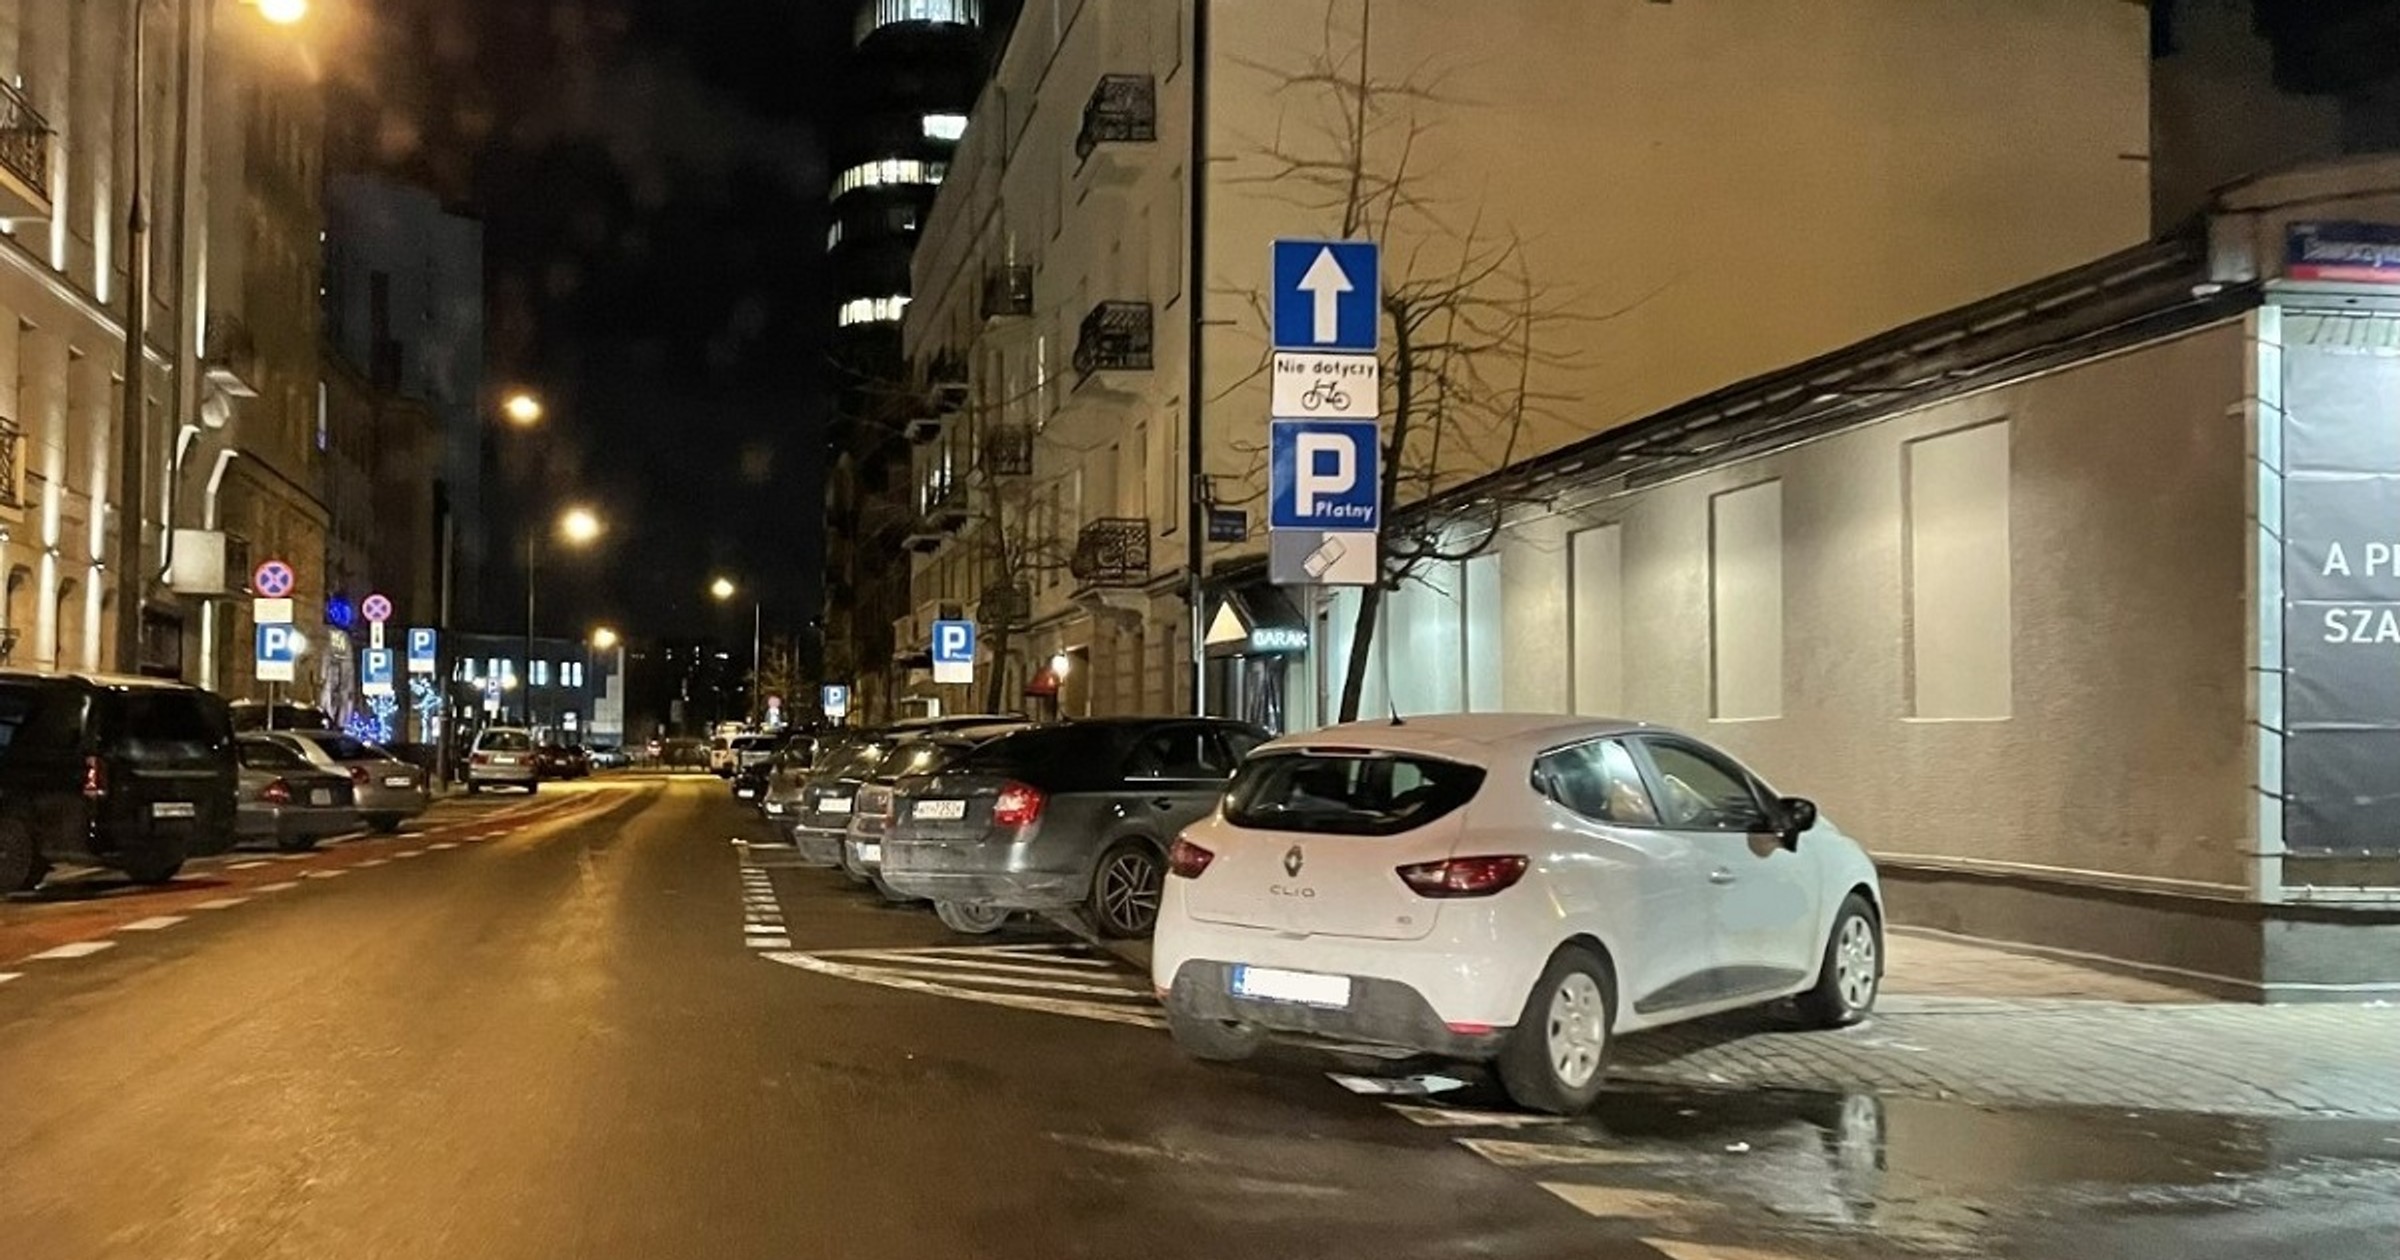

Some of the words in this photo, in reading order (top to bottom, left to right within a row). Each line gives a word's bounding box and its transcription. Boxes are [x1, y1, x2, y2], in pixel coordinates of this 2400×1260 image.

[1278, 360, 1305, 374] Nie
[1313, 360, 1374, 379] dotyczy
[1296, 432, 1356, 517] P
[2322, 541, 2351, 576] A
[2323, 608, 2400, 643] SZA
[265, 628, 286, 658] P
[414, 631, 431, 652] P
[943, 626, 966, 659] P
[369, 651, 387, 675] P
[829, 687, 842, 704] P
[1269, 884, 1315, 898] CLIO
